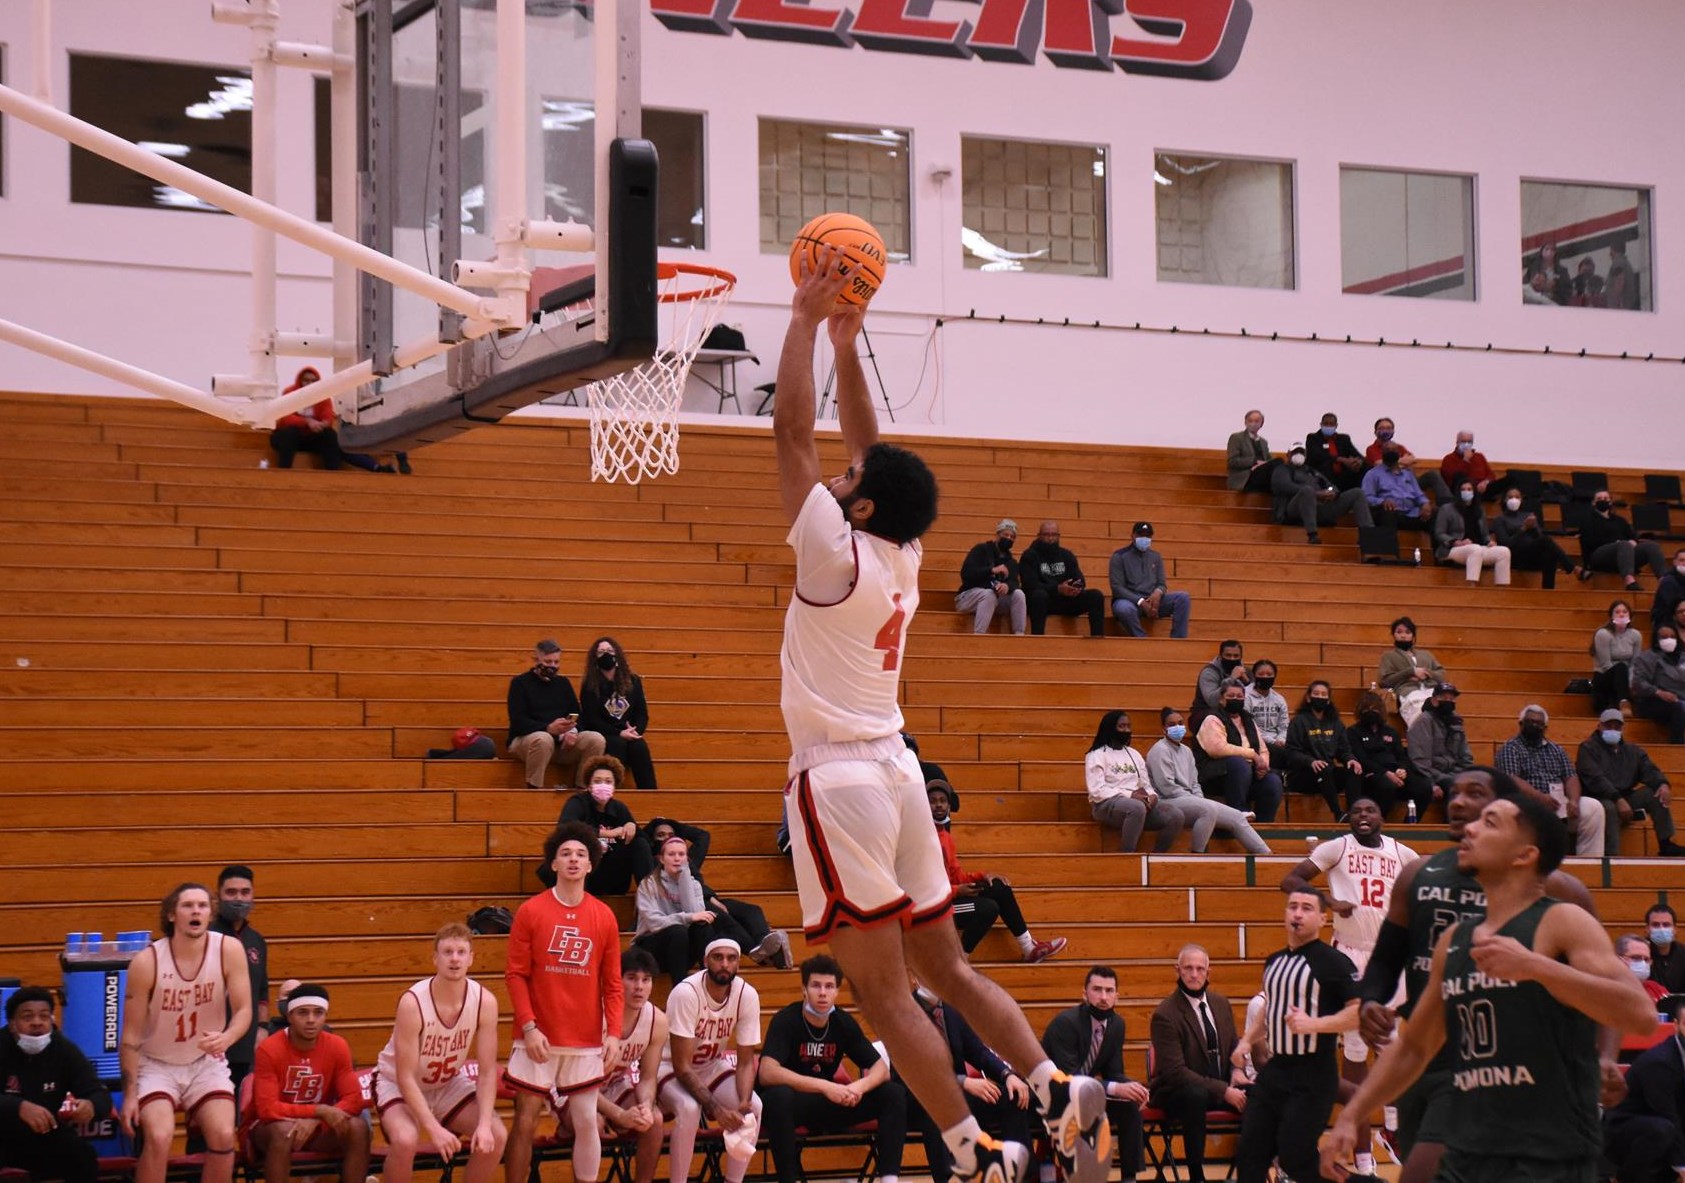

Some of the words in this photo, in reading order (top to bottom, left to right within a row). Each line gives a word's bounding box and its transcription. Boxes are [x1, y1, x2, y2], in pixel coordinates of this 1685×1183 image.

[874, 593, 906, 671] 4
[1348, 854, 1375, 875] EAST
[1380, 857, 1396, 880] BAY
[1361, 877, 1385, 909] 12
[1417, 886, 1456, 903] CAL
[1459, 890, 1488, 907] PO
[547, 925, 593, 967] EB
[105, 976, 119, 1049] POWERADE
[161, 988, 191, 1012] EAST
[194, 982, 215, 1007] BAY
[174, 1011, 198, 1043] 11
[421, 1034, 450, 1057] EAST
[283, 1065, 325, 1104] EB
[421, 1055, 458, 1085] 35
